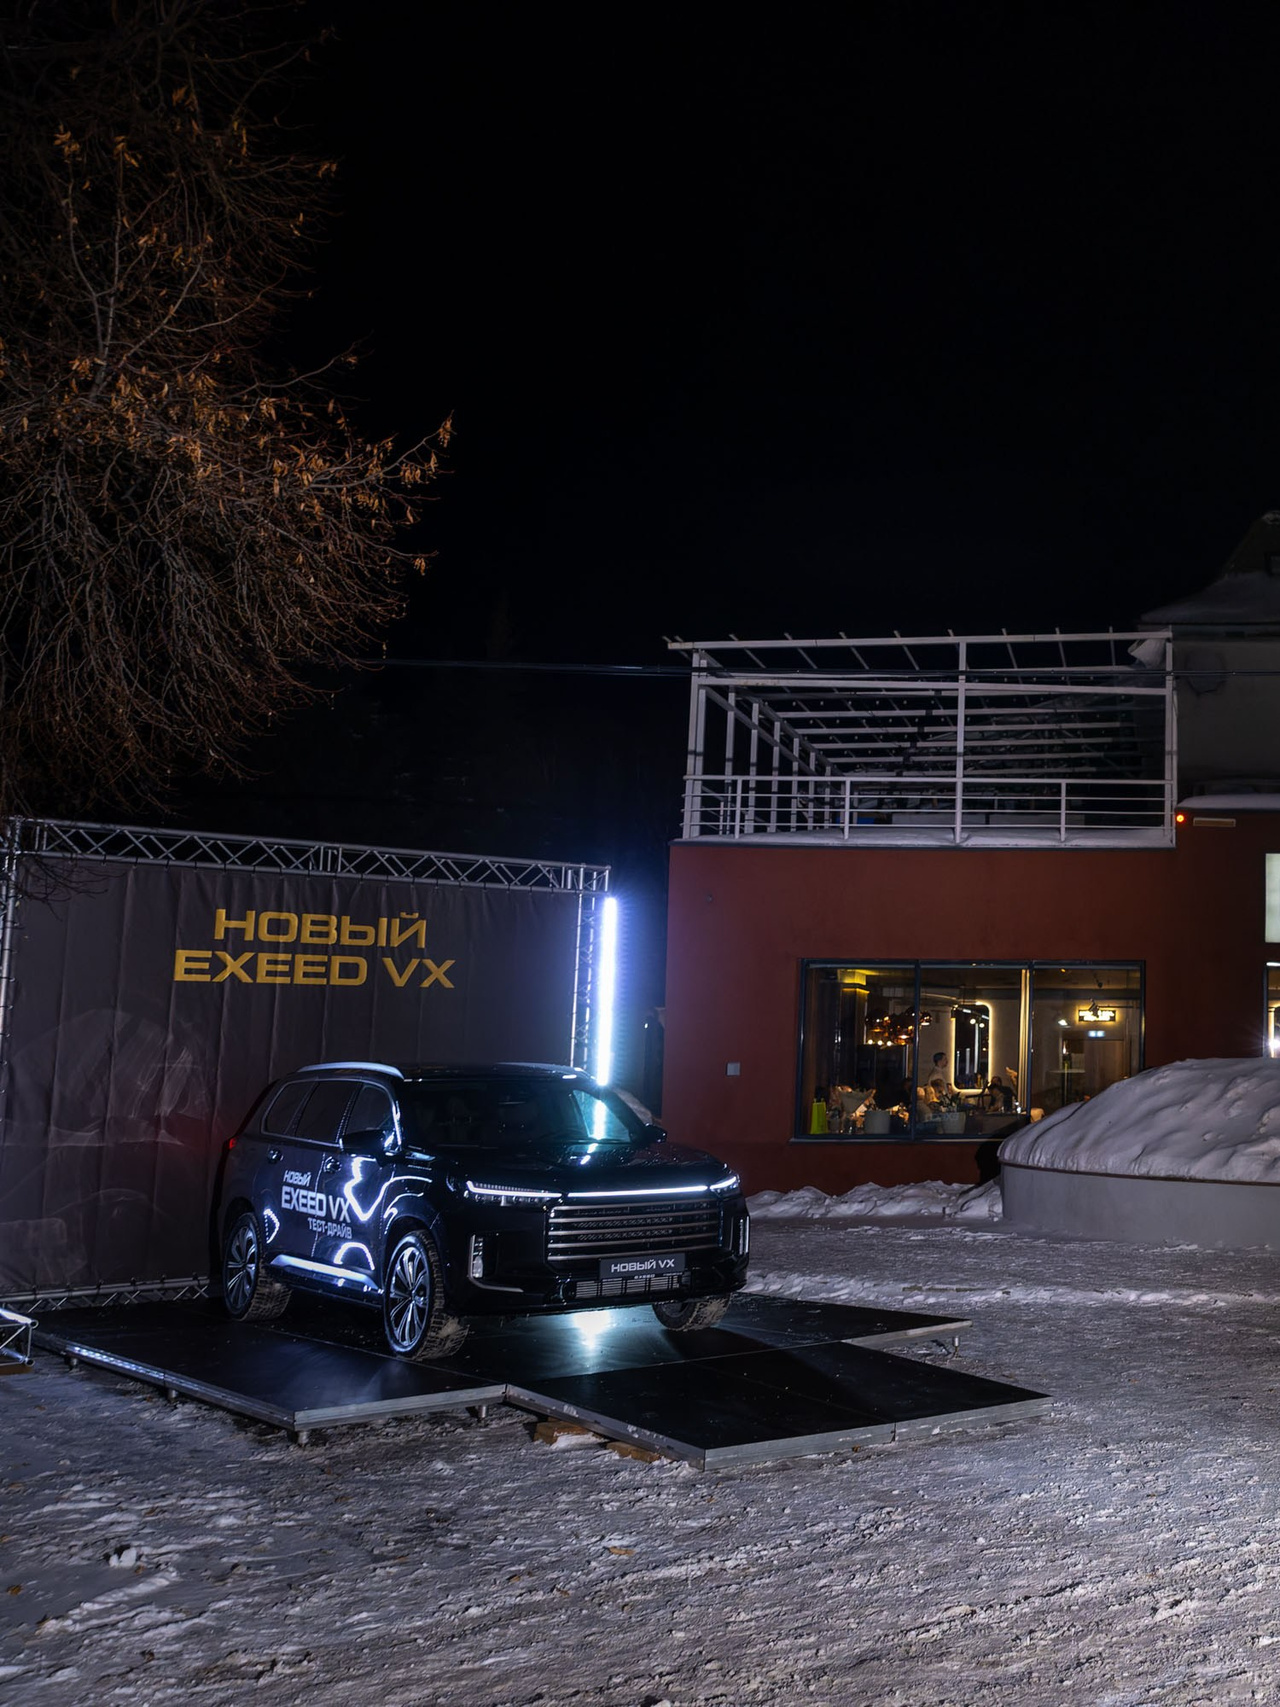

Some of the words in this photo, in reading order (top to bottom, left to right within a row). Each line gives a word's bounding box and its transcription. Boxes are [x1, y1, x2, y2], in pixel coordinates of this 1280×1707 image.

[213, 908, 427, 949] НОВЫЙ
[172, 949, 368, 987] EXEED
[381, 956, 456, 990] VX
[283, 1170, 311, 1186] НОВЫЙ
[282, 1186, 326, 1216] EXEED
[328, 1195, 351, 1223] VX
[308, 1218, 352, 1239] ТЕСТ-ДРАЙВ
[611, 1260, 656, 1273] НОВЫЙ
[658, 1259, 674, 1268] VX
